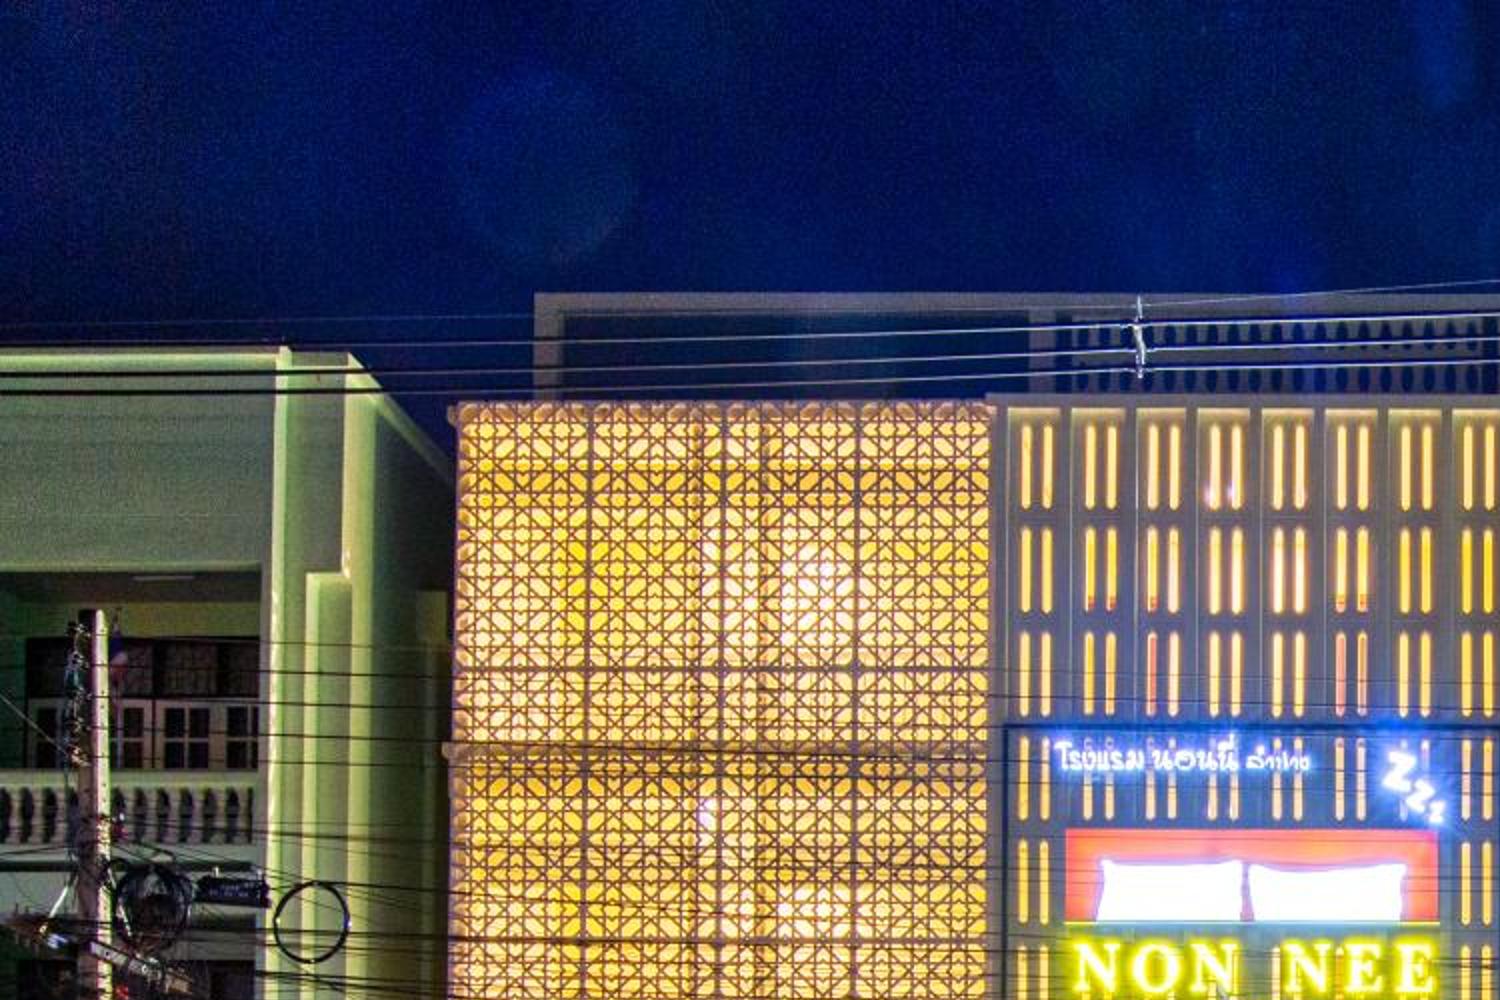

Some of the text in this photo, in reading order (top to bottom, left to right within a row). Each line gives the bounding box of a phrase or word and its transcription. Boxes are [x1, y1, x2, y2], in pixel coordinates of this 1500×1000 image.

[1054, 732, 1312, 771] โรงแรม นอนนี่ ลำปาง
[1073, 942, 1436, 993] NON NEE
